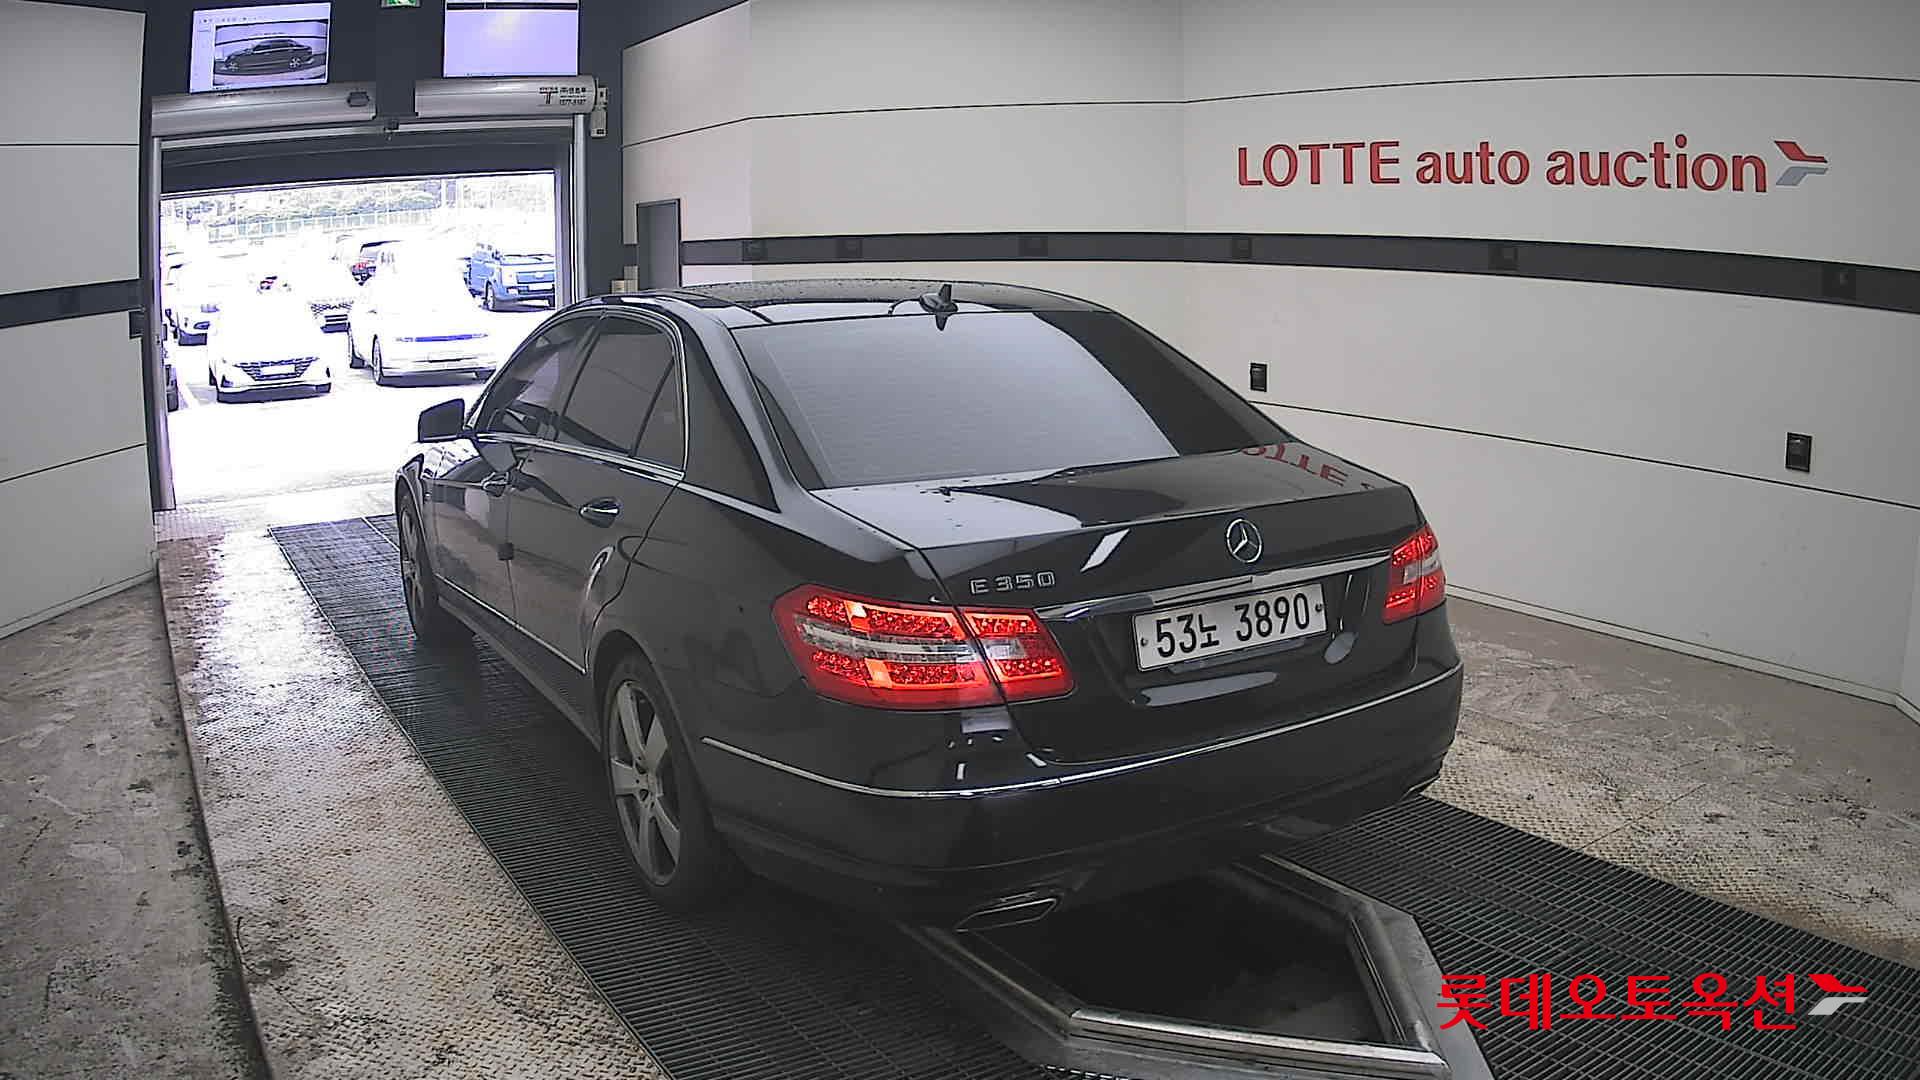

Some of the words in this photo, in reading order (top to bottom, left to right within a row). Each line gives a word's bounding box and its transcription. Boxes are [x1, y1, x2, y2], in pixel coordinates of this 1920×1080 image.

[1237, 140, 1400, 187] LOTTE
[1415, 141, 1530, 184] auto
[1546, 134, 1767, 193] auction
[970, 578, 990, 595] E
[995, 571, 1056, 592] 350
[1156, 613, 1220, 658] 53노
[1234, 592, 1310, 642] 3890
